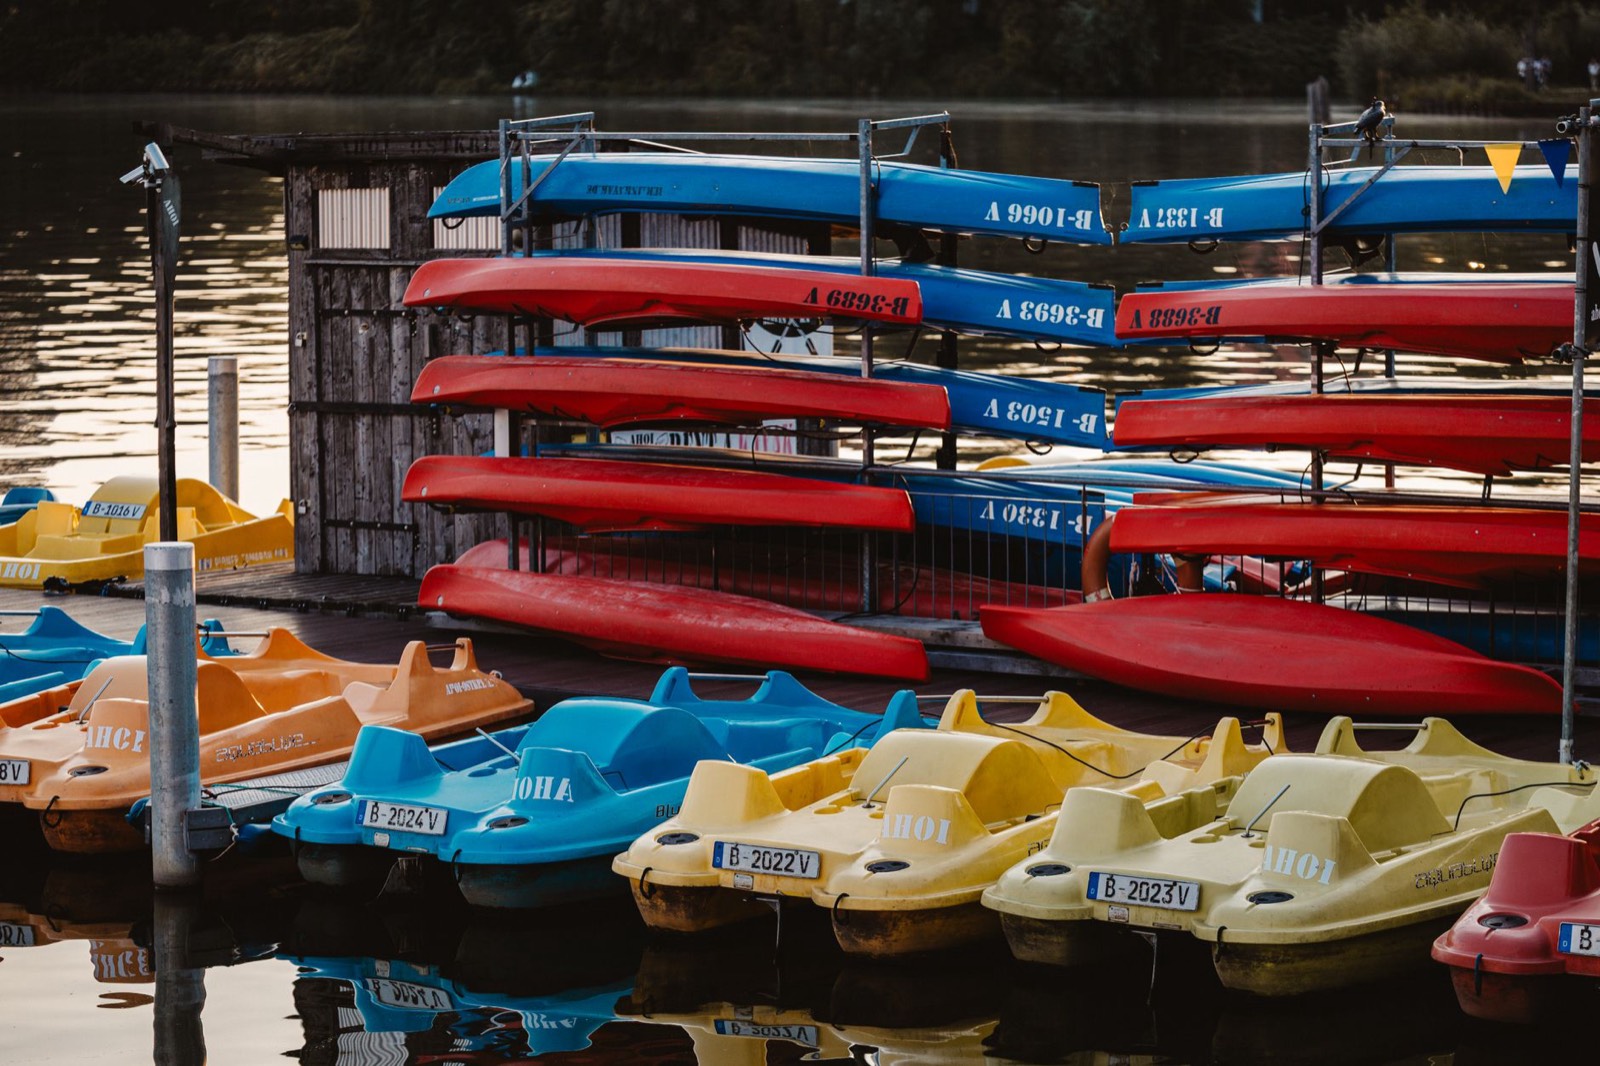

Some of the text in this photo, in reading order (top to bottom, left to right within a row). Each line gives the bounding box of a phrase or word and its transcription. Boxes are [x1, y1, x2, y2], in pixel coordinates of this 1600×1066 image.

[163, 199, 180, 227] AHOI
[984, 201, 1093, 231] B-1066 V
[1138, 208, 1151, 228] V
[802, 287, 909, 317] B-3689 V
[995, 299, 1105, 329] B-3693 V
[1129, 306, 1222, 329] B-3688 V
[983, 398, 999, 418] V
[92, 502, 140, 517] B-1016 V
[979, 500, 995, 521] V
[0, 563, 41, 580] HOI
[11, 763, 22, 782] V
[369, 804, 424, 829] B-2024
[428, 811, 439, 831] V
[881, 813, 952, 846] AHOI
[729, 846, 795, 873] B-2022
[799, 854, 811, 874] V
[1262, 844, 1337, 886] AHOI
[1104, 877, 1174, 904] B-2023
[1178, 885, 1190, 905] V
